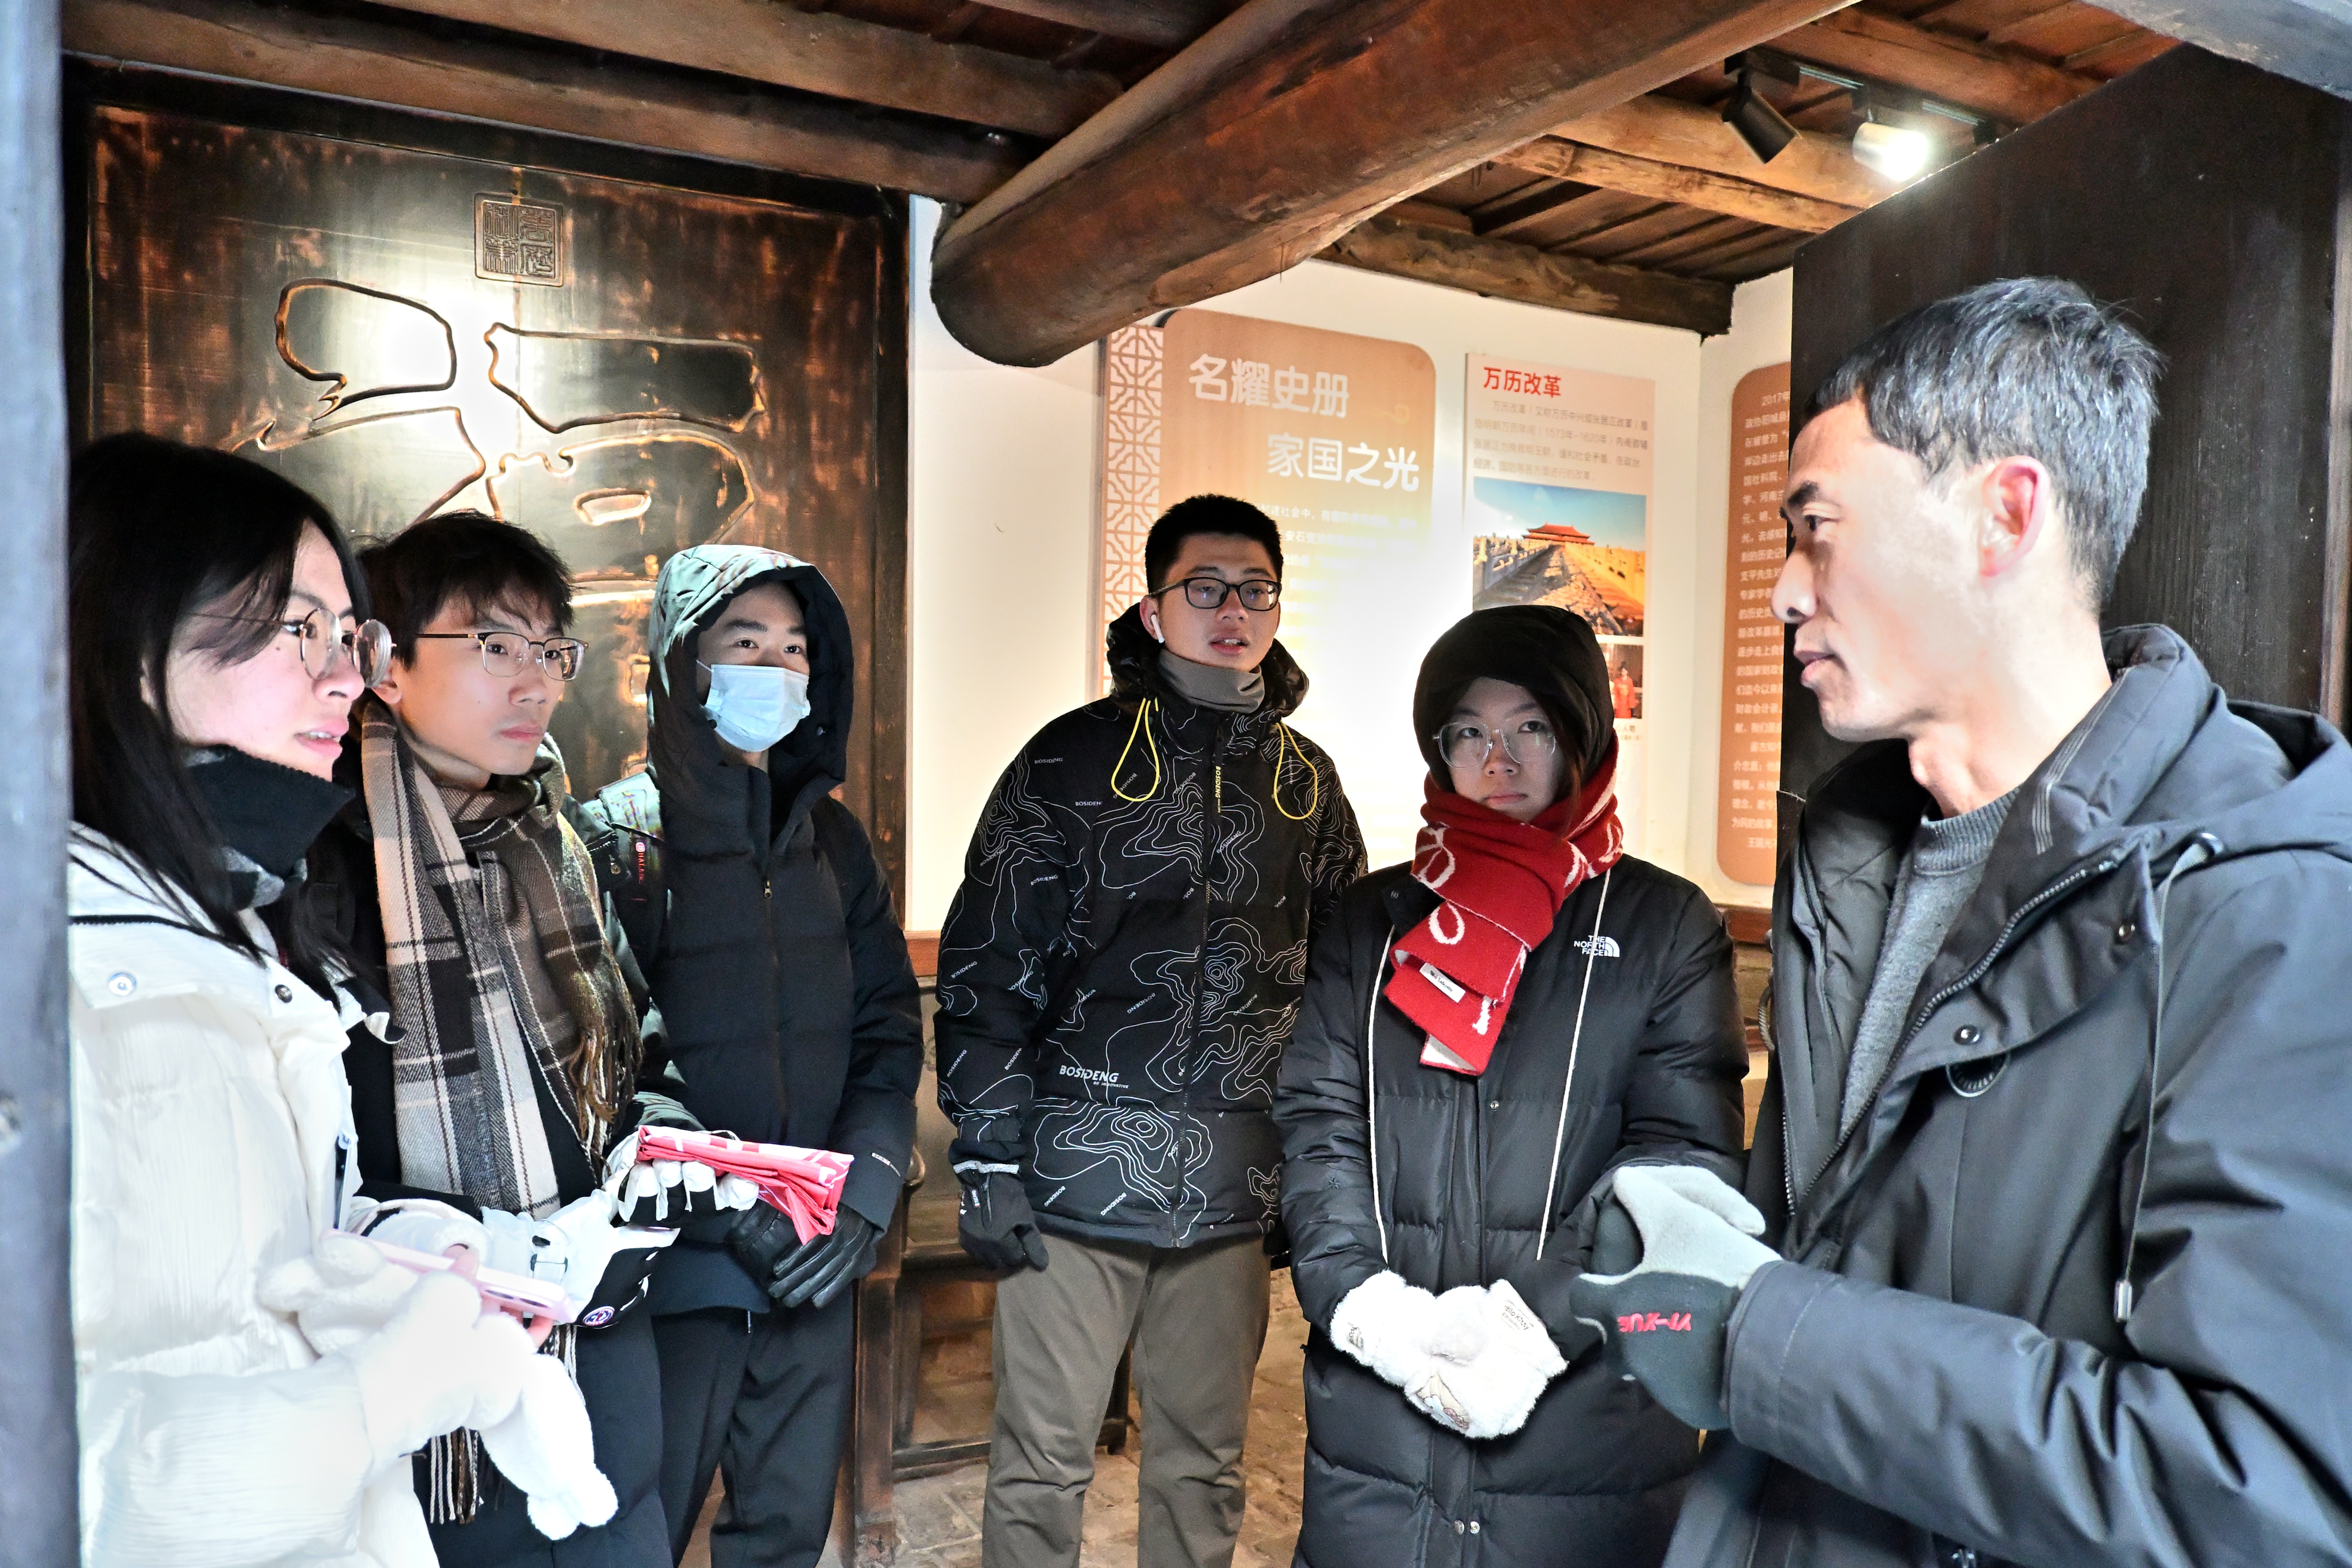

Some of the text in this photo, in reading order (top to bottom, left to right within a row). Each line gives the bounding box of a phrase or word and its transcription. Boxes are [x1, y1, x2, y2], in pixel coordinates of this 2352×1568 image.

[1189, 354, 1349, 418] 名耀史册
[1483, 366, 1562, 398] 万历改革
[1267, 432, 1419, 492] 家国之光
[1216, 830, 1241, 854] BOSIDENG
[1030, 874, 1058, 886] BOSIDENG
[1582, 948, 1605, 956] FACE
[951, 961, 978, 978] BOSIDENG
[1127, 992, 1156, 1014] BOSIDENG
[1233, 993, 1258, 1016] BOSIDENG
[1059, 1065, 1120, 1083] BOSIDENG
[1044, 1185, 1066, 1207] BOSIDENG
[1100, 1192, 1127, 1216] BOSIDENG
[1504, 1305, 1530, 1330] ello Kitty
[1617, 1312, 1692, 1333] YI-XUE
